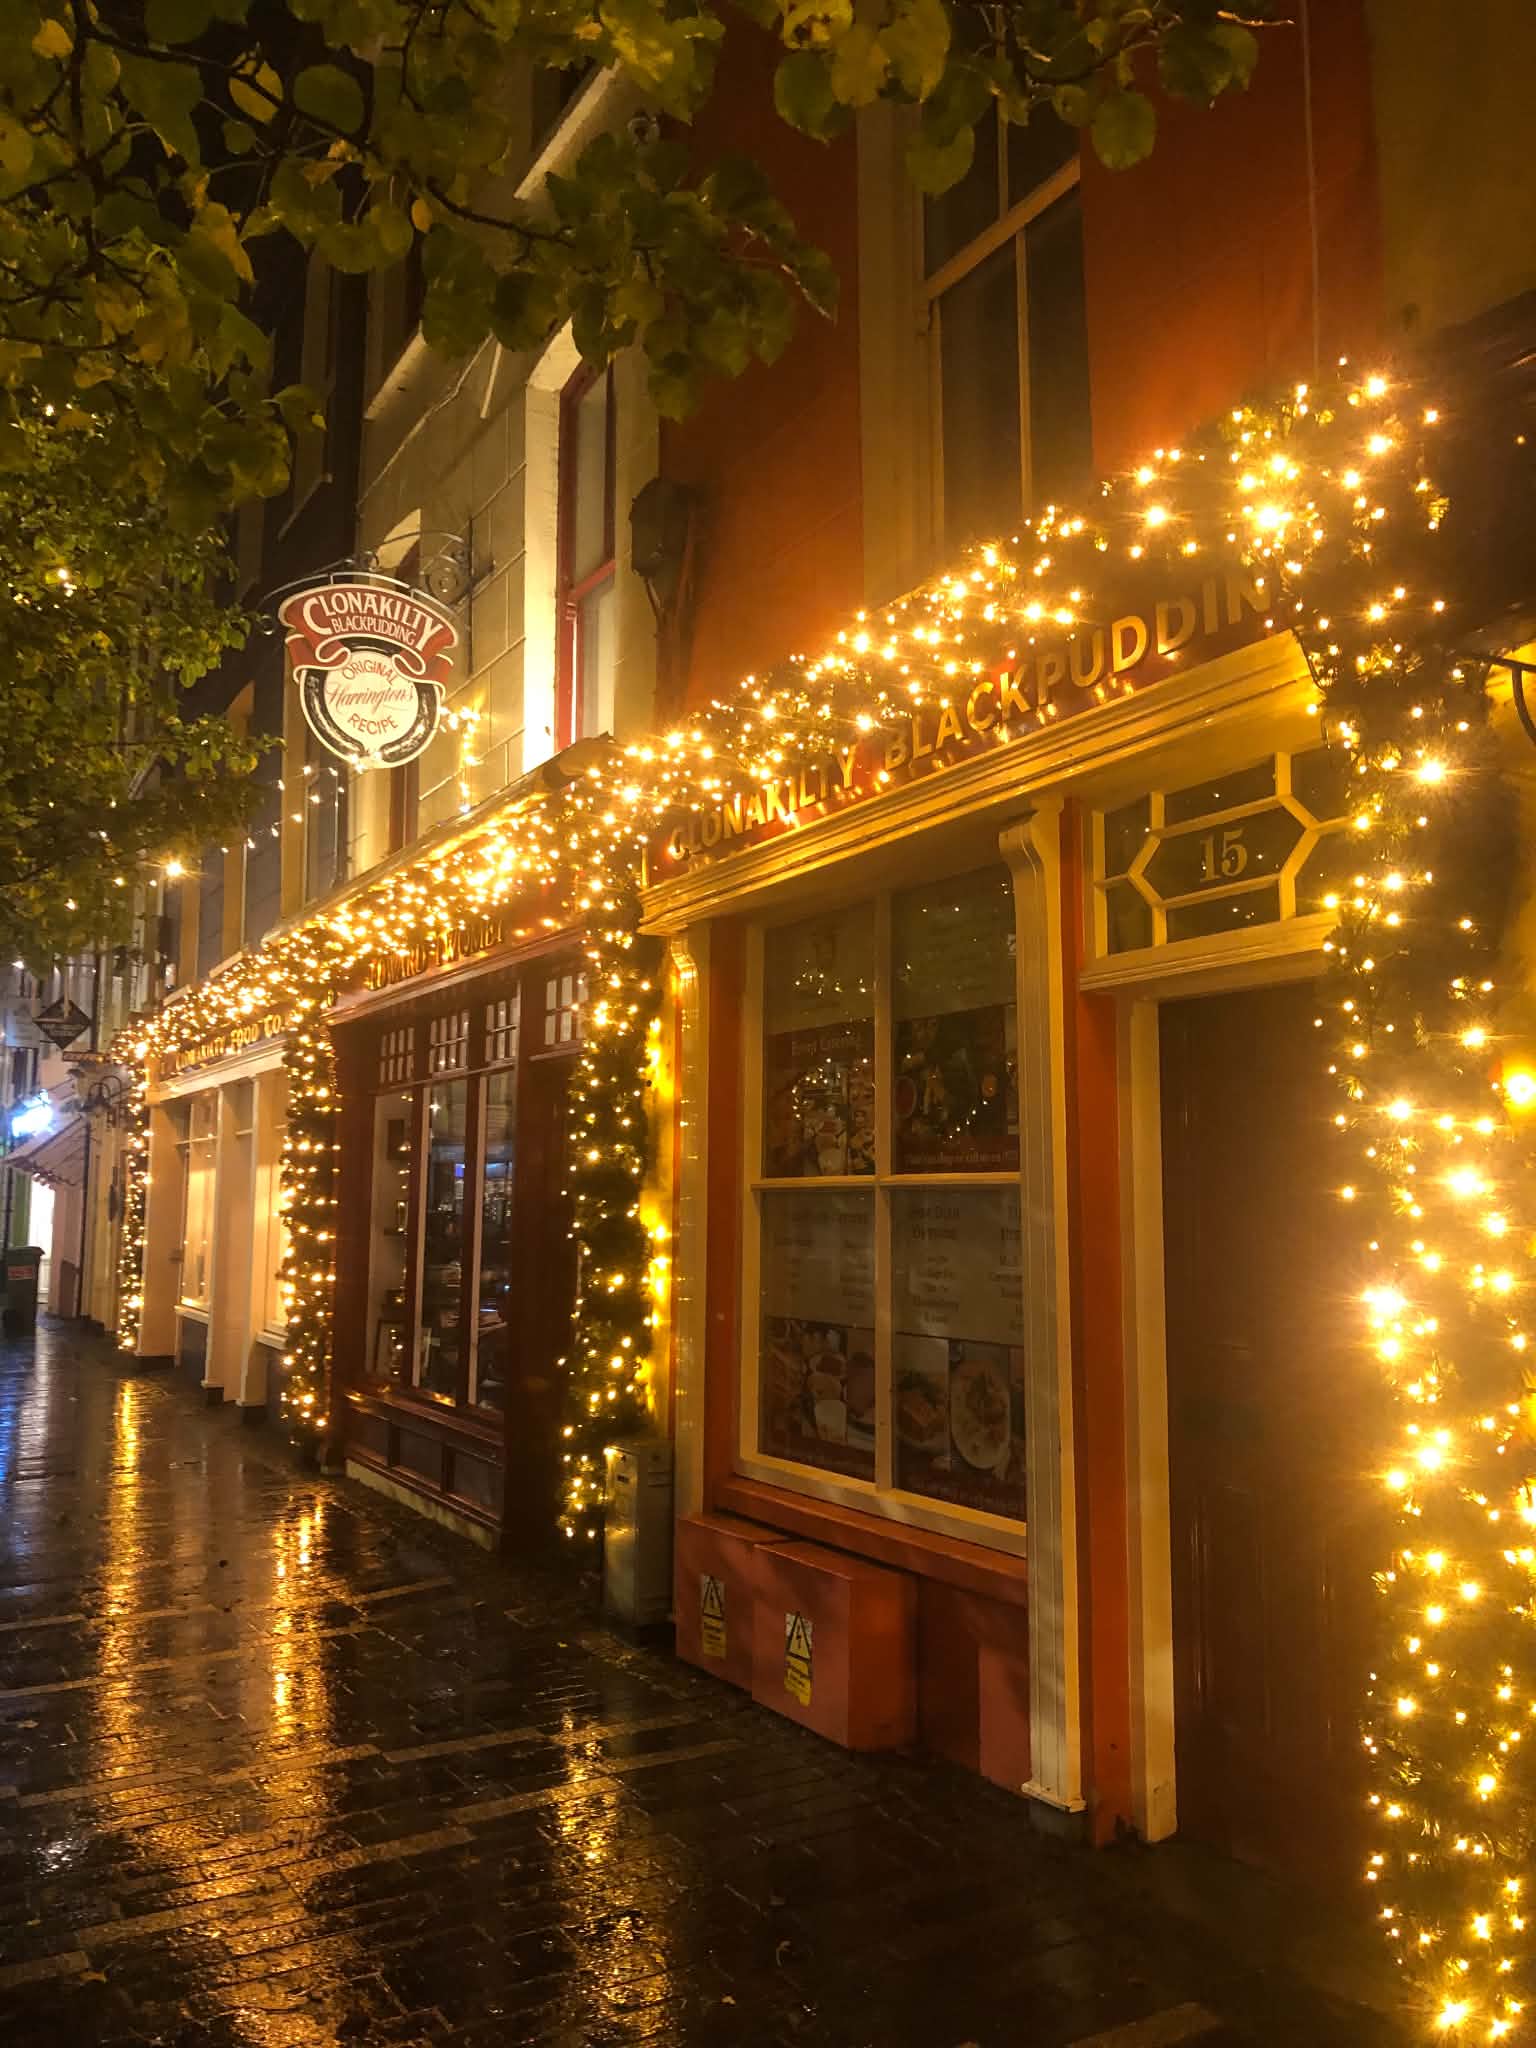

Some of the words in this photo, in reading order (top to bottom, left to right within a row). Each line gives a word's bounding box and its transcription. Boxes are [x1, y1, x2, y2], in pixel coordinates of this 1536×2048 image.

[303, 591, 443, 652] CLONAKILTY
[331, 615, 417, 646] BLACKPUDDING
[342, 659, 398, 686] ORIGINAL
[884, 566, 1271, 771] BLACKPUDDIN
[348, 712, 398, 736] RECIPE
[1201, 828, 1248, 882] 15
